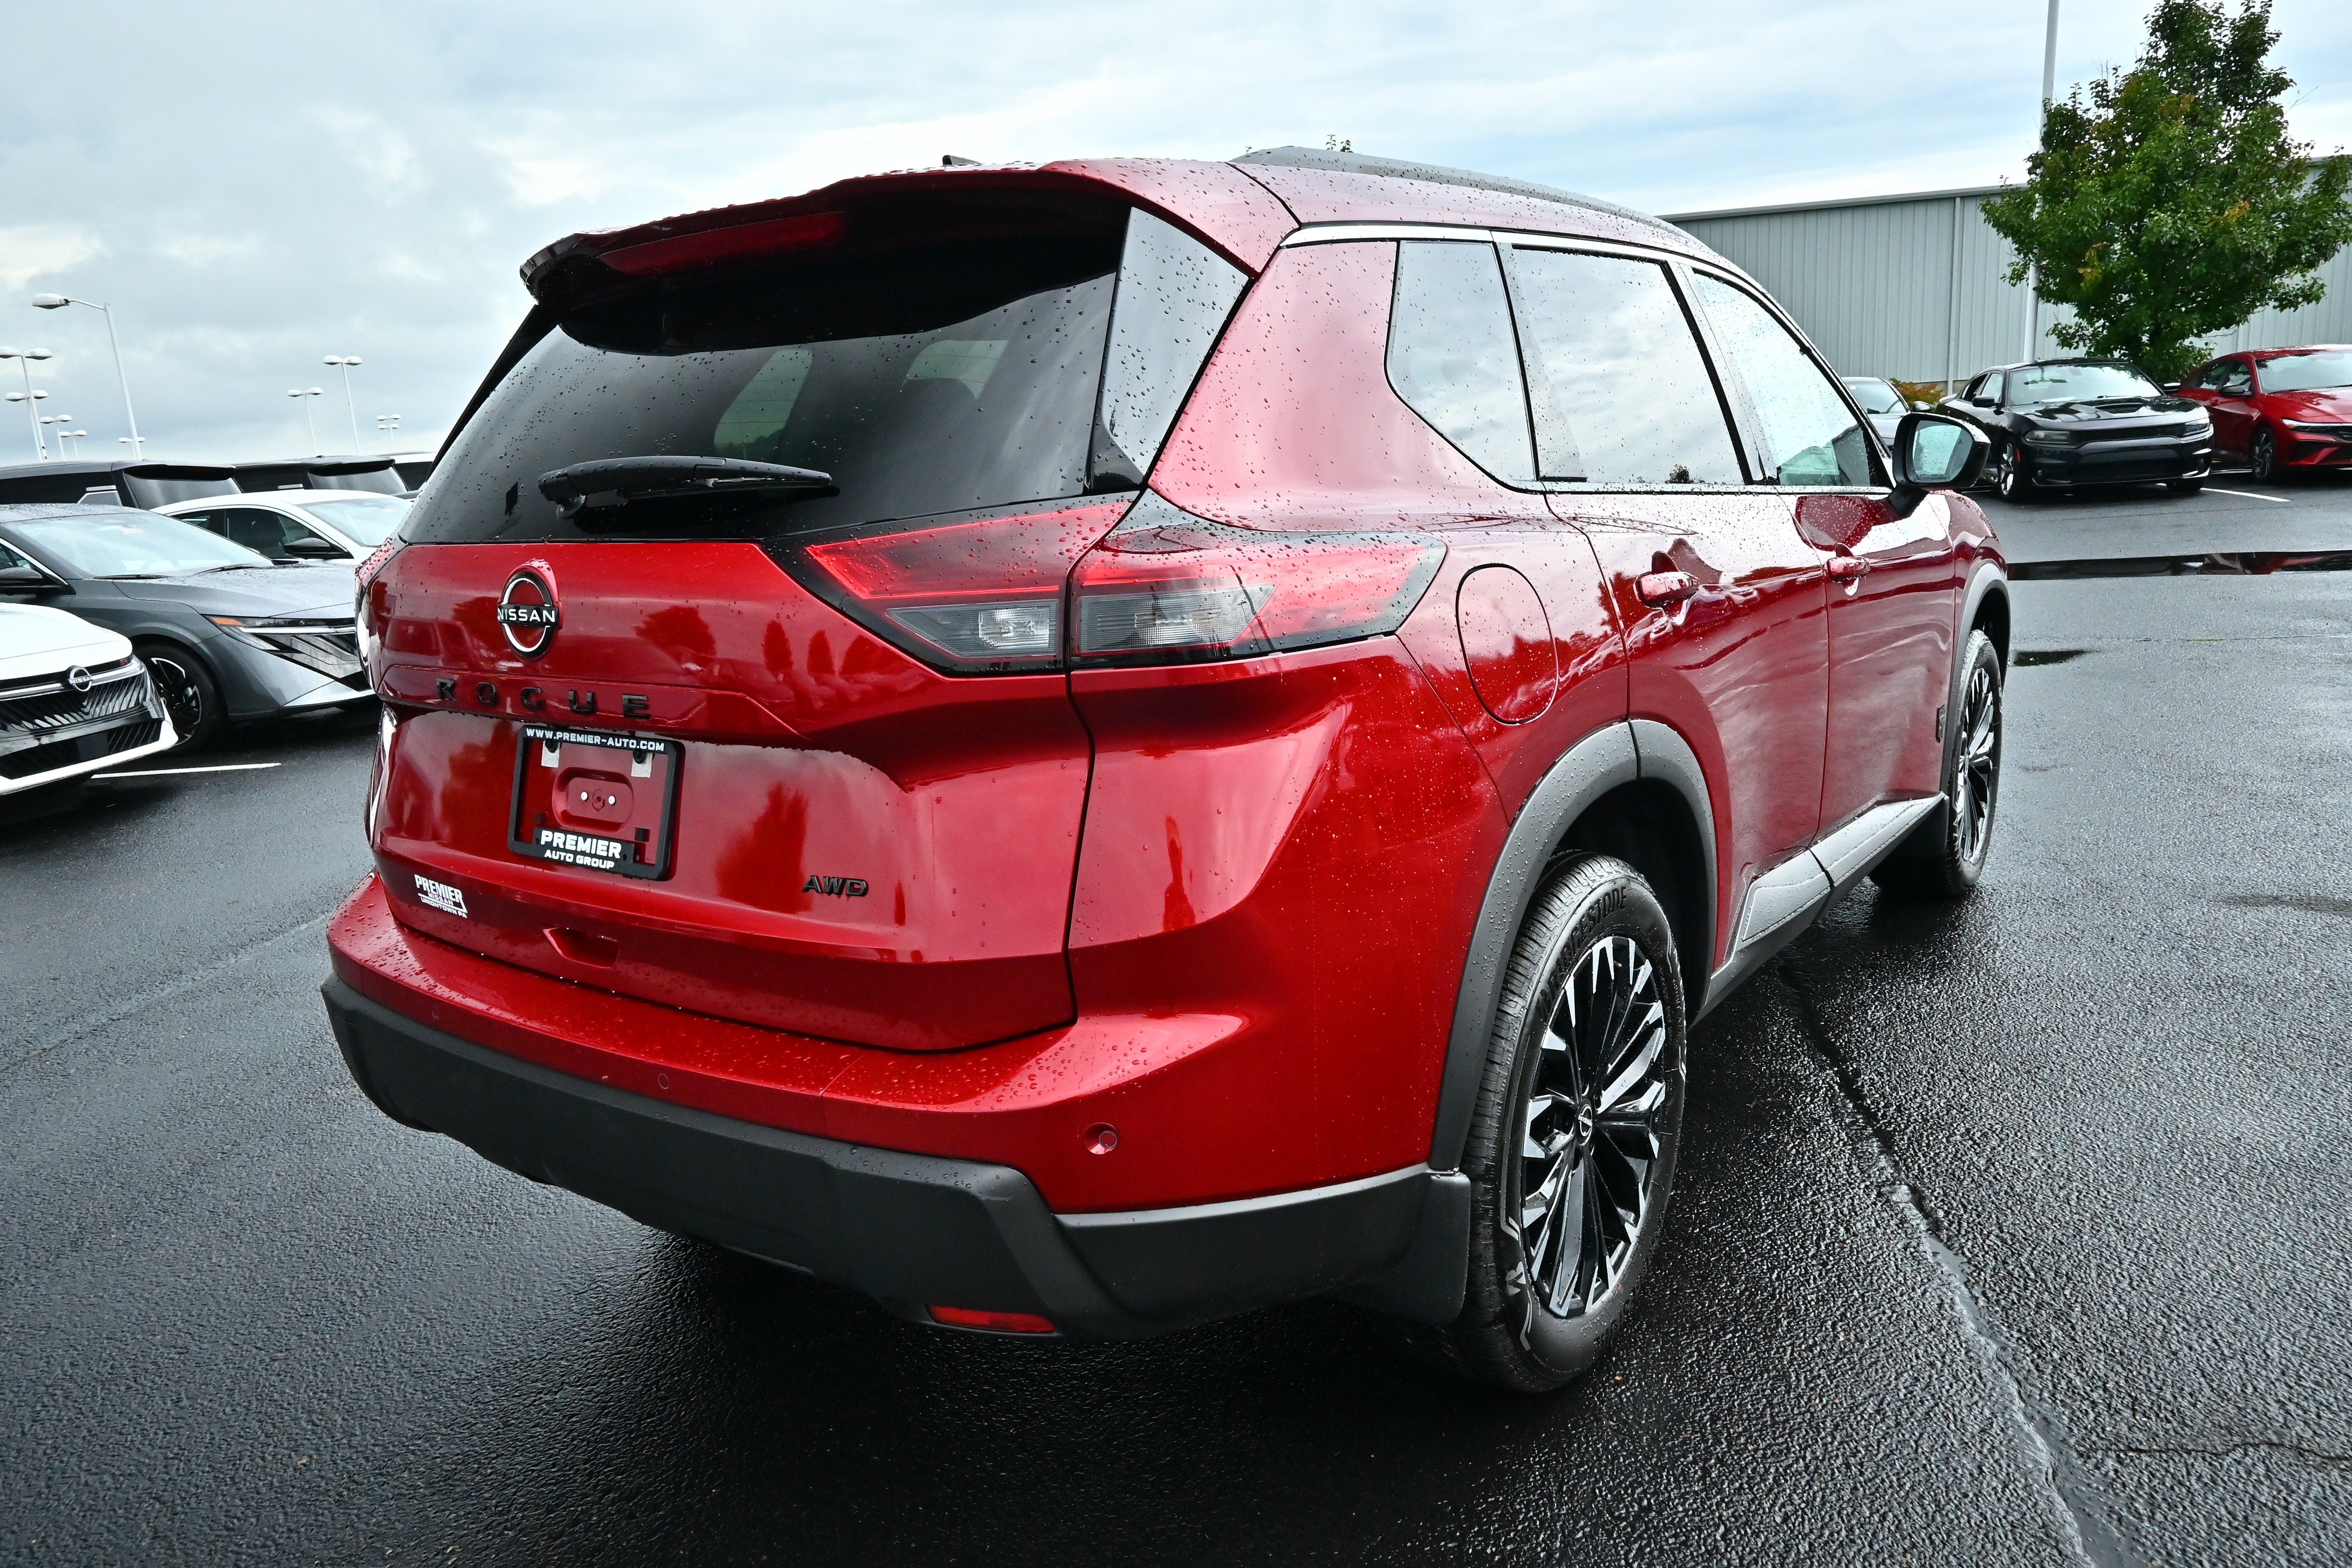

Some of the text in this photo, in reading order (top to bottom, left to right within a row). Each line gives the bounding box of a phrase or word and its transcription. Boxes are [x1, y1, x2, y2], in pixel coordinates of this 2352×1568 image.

[497, 607, 555, 623] NISSAN
[436, 678, 651, 720] ROGUE
[525, 728, 665, 752] WWW.PREMIER-AUTO.COM
[540, 830, 622, 859] PREMIER
[544, 849, 615, 869] AUTO GROUP
[414, 874, 463, 903] PREMIER
[801, 875, 869, 897] AWD
[420, 896, 457, 915] UNIONTOWN
[428, 892, 454, 906] NISSAN
